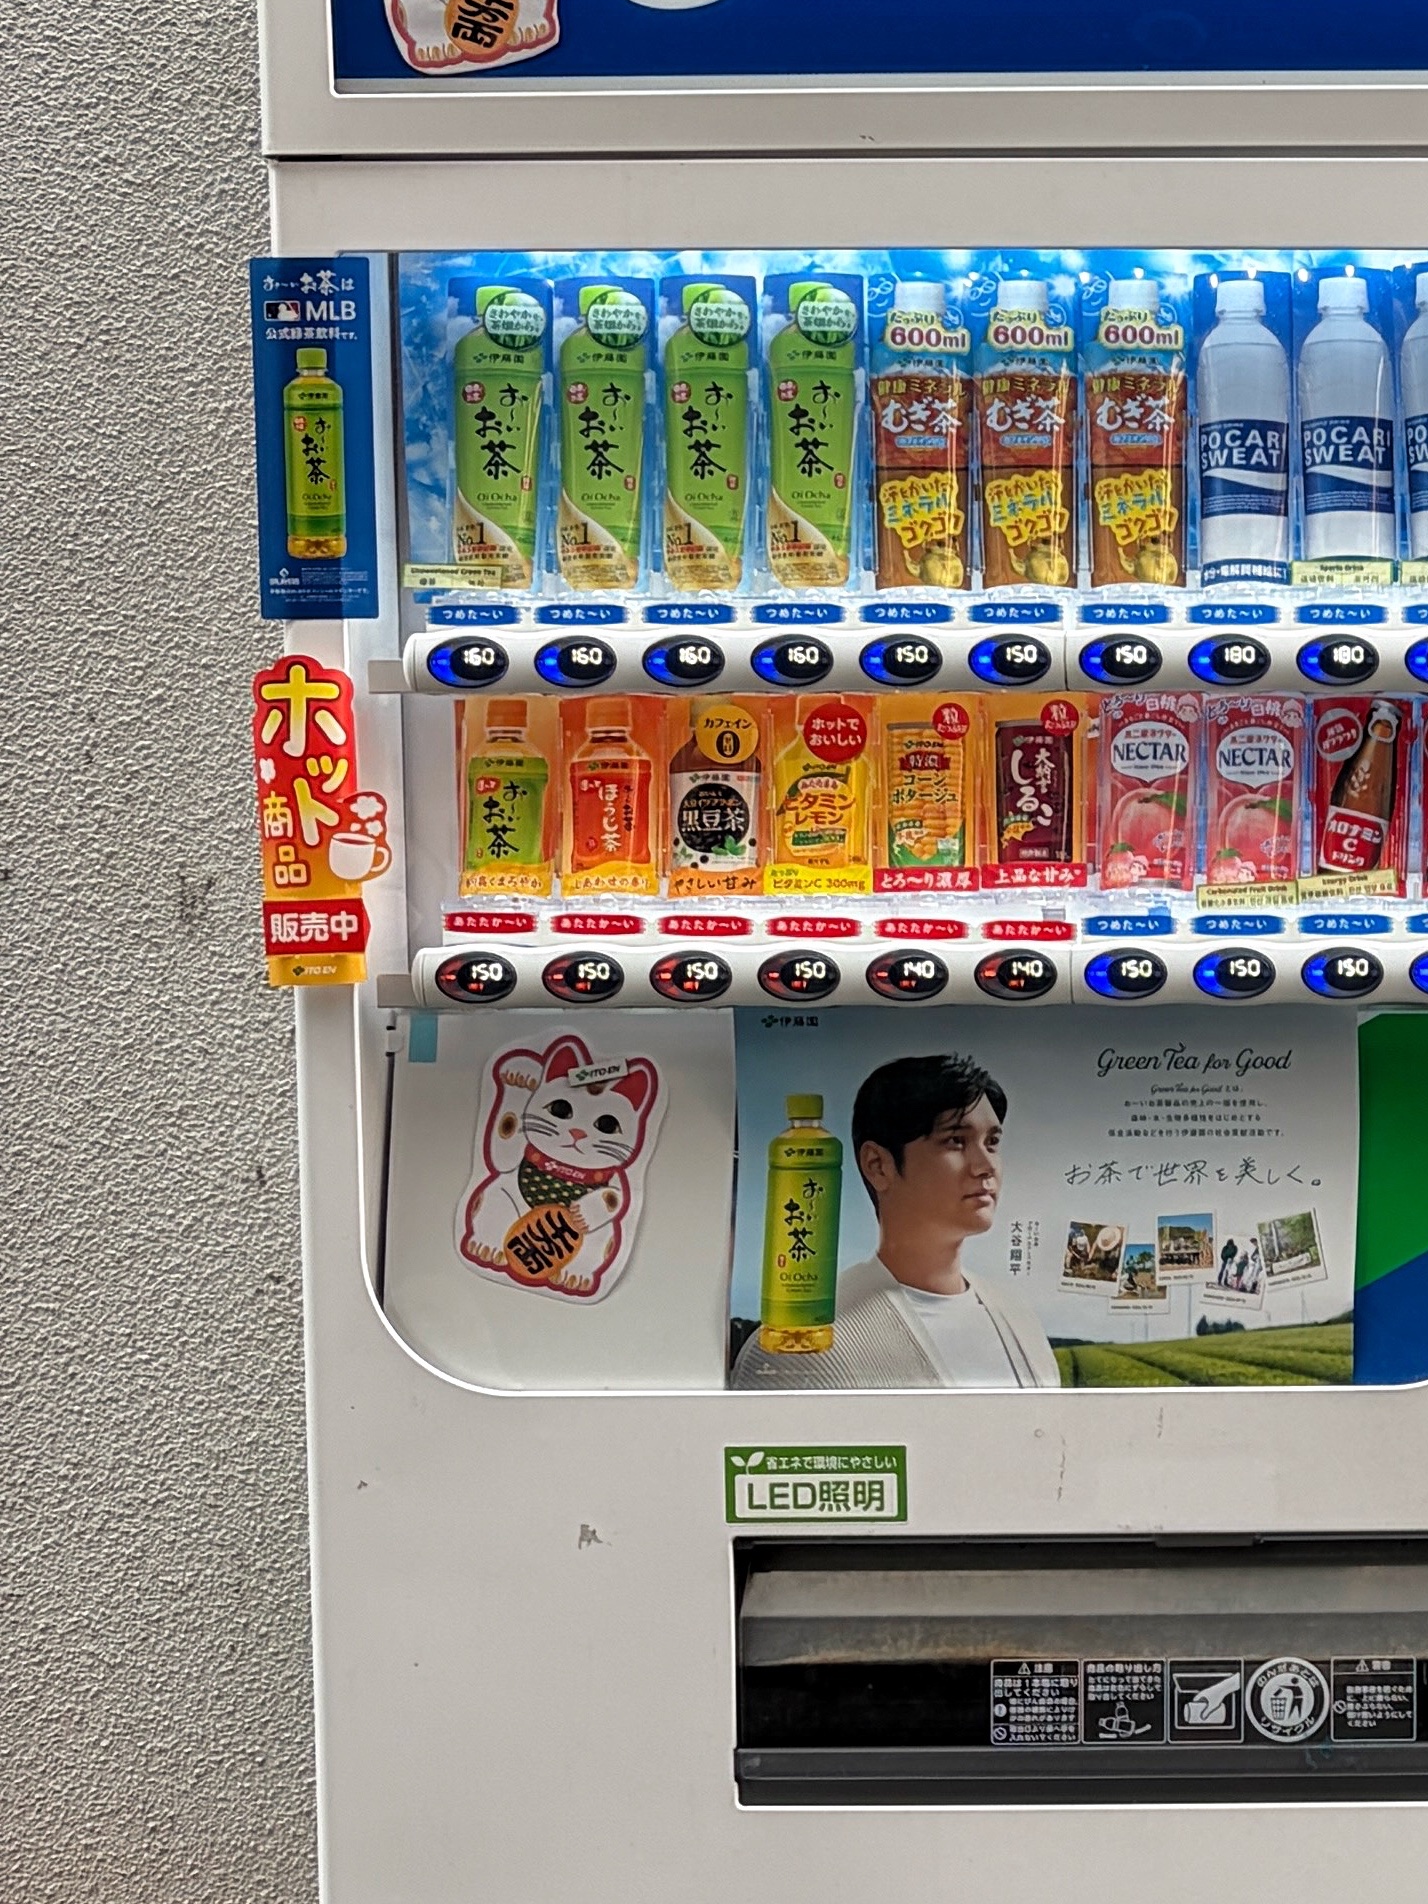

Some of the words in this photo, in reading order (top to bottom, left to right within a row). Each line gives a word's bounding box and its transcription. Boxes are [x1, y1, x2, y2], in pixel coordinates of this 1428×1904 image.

[305, 300, 356, 322] MLB
[890, 310, 936, 326] たっぷり
[993, 310, 1037, 326] たっぷり
[890, 326, 966, 348] 600ml
[993, 326, 1069, 347] 600ml
[1105, 326, 1180, 347] 600ml
[881, 397, 963, 434] むぎ茶
[986, 396, 1066, 433] むぎ茶
[1096, 396, 1176, 433] むぎ茶
[474, 405, 522, 480] お茶
[578, 405, 625, 480] お茶
[680, 404, 727, 479] お茶
[788, 404, 835, 479] お茶
[1201, 431, 1286, 451] POCARI
[1303, 426, 1392, 447] POCARI
[1201, 449, 1281, 468] SWEAT
[1304, 446, 1387, 466] SWEAT
[902, 512, 961, 544] ゴクゴク
[1008, 510, 1067, 544] ゴクゴク
[464, 647, 495, 665] 160
[572, 647, 603, 665] 160
[679, 647, 711, 664] 160
[788, 646, 819, 664] 160
[897, 646, 928, 663] 150
[1005, 646, 1037, 663] 150
[1115, 646, 1147, 663] 150
[1224, 646, 1256, 664] 180
[1332, 646, 1364, 664] 180
[703, 718, 752, 730] カフェイン
[811, 717, 859, 731] ホットで
[808, 733, 862, 746] おいしい
[1112, 743, 1188, 763] NECTAR
[1218, 748, 1292, 768] NECTAR
[903, 773, 946, 787] コーン
[1010, 749, 1054, 826] しるこ
[785, 793, 857, 812] ビタミン
[891, 788, 959, 804] ポタージュ
[597, 782, 623, 853] ほうじ茶
[681, 811, 746, 833] 黒豆茶
[794, 810, 844, 826] レモン
[262, 791, 307, 885] 商品
[1328, 819, 1383, 845] オロナミン
[1342, 837, 1358, 852] C
[673, 875, 757, 892] やさしい甘み
[773, 877, 823, 890] ビタミンC
[826, 877, 866, 890] 300mg
[994, 867, 1081, 885] 上品な甘み
[270, 911, 359, 943] 販売中
[471, 963, 503, 980] 150
[578, 963, 610, 980] 150
[686, 962, 719, 980] 150
[794, 961, 826, 979] 150
[902, 960, 935, 978] 140
[1010, 960, 1043, 978] 140
[1120, 960, 1152, 977] 150
[1097, 1047, 1162, 1077] Green
[1163, 1042, 1200, 1071] Tea
[1202, 1053, 1232, 1074] for
[1235, 1047, 1293, 1077] Good
[1064, 1156, 1324, 1188] お茶で世界を美しく。
[766, 1455, 898, 1471] 省エネで環境にやさしい
[747, 1480, 885, 1512] LED照明
[1260, 1716, 1316, 1737] リサイクル
